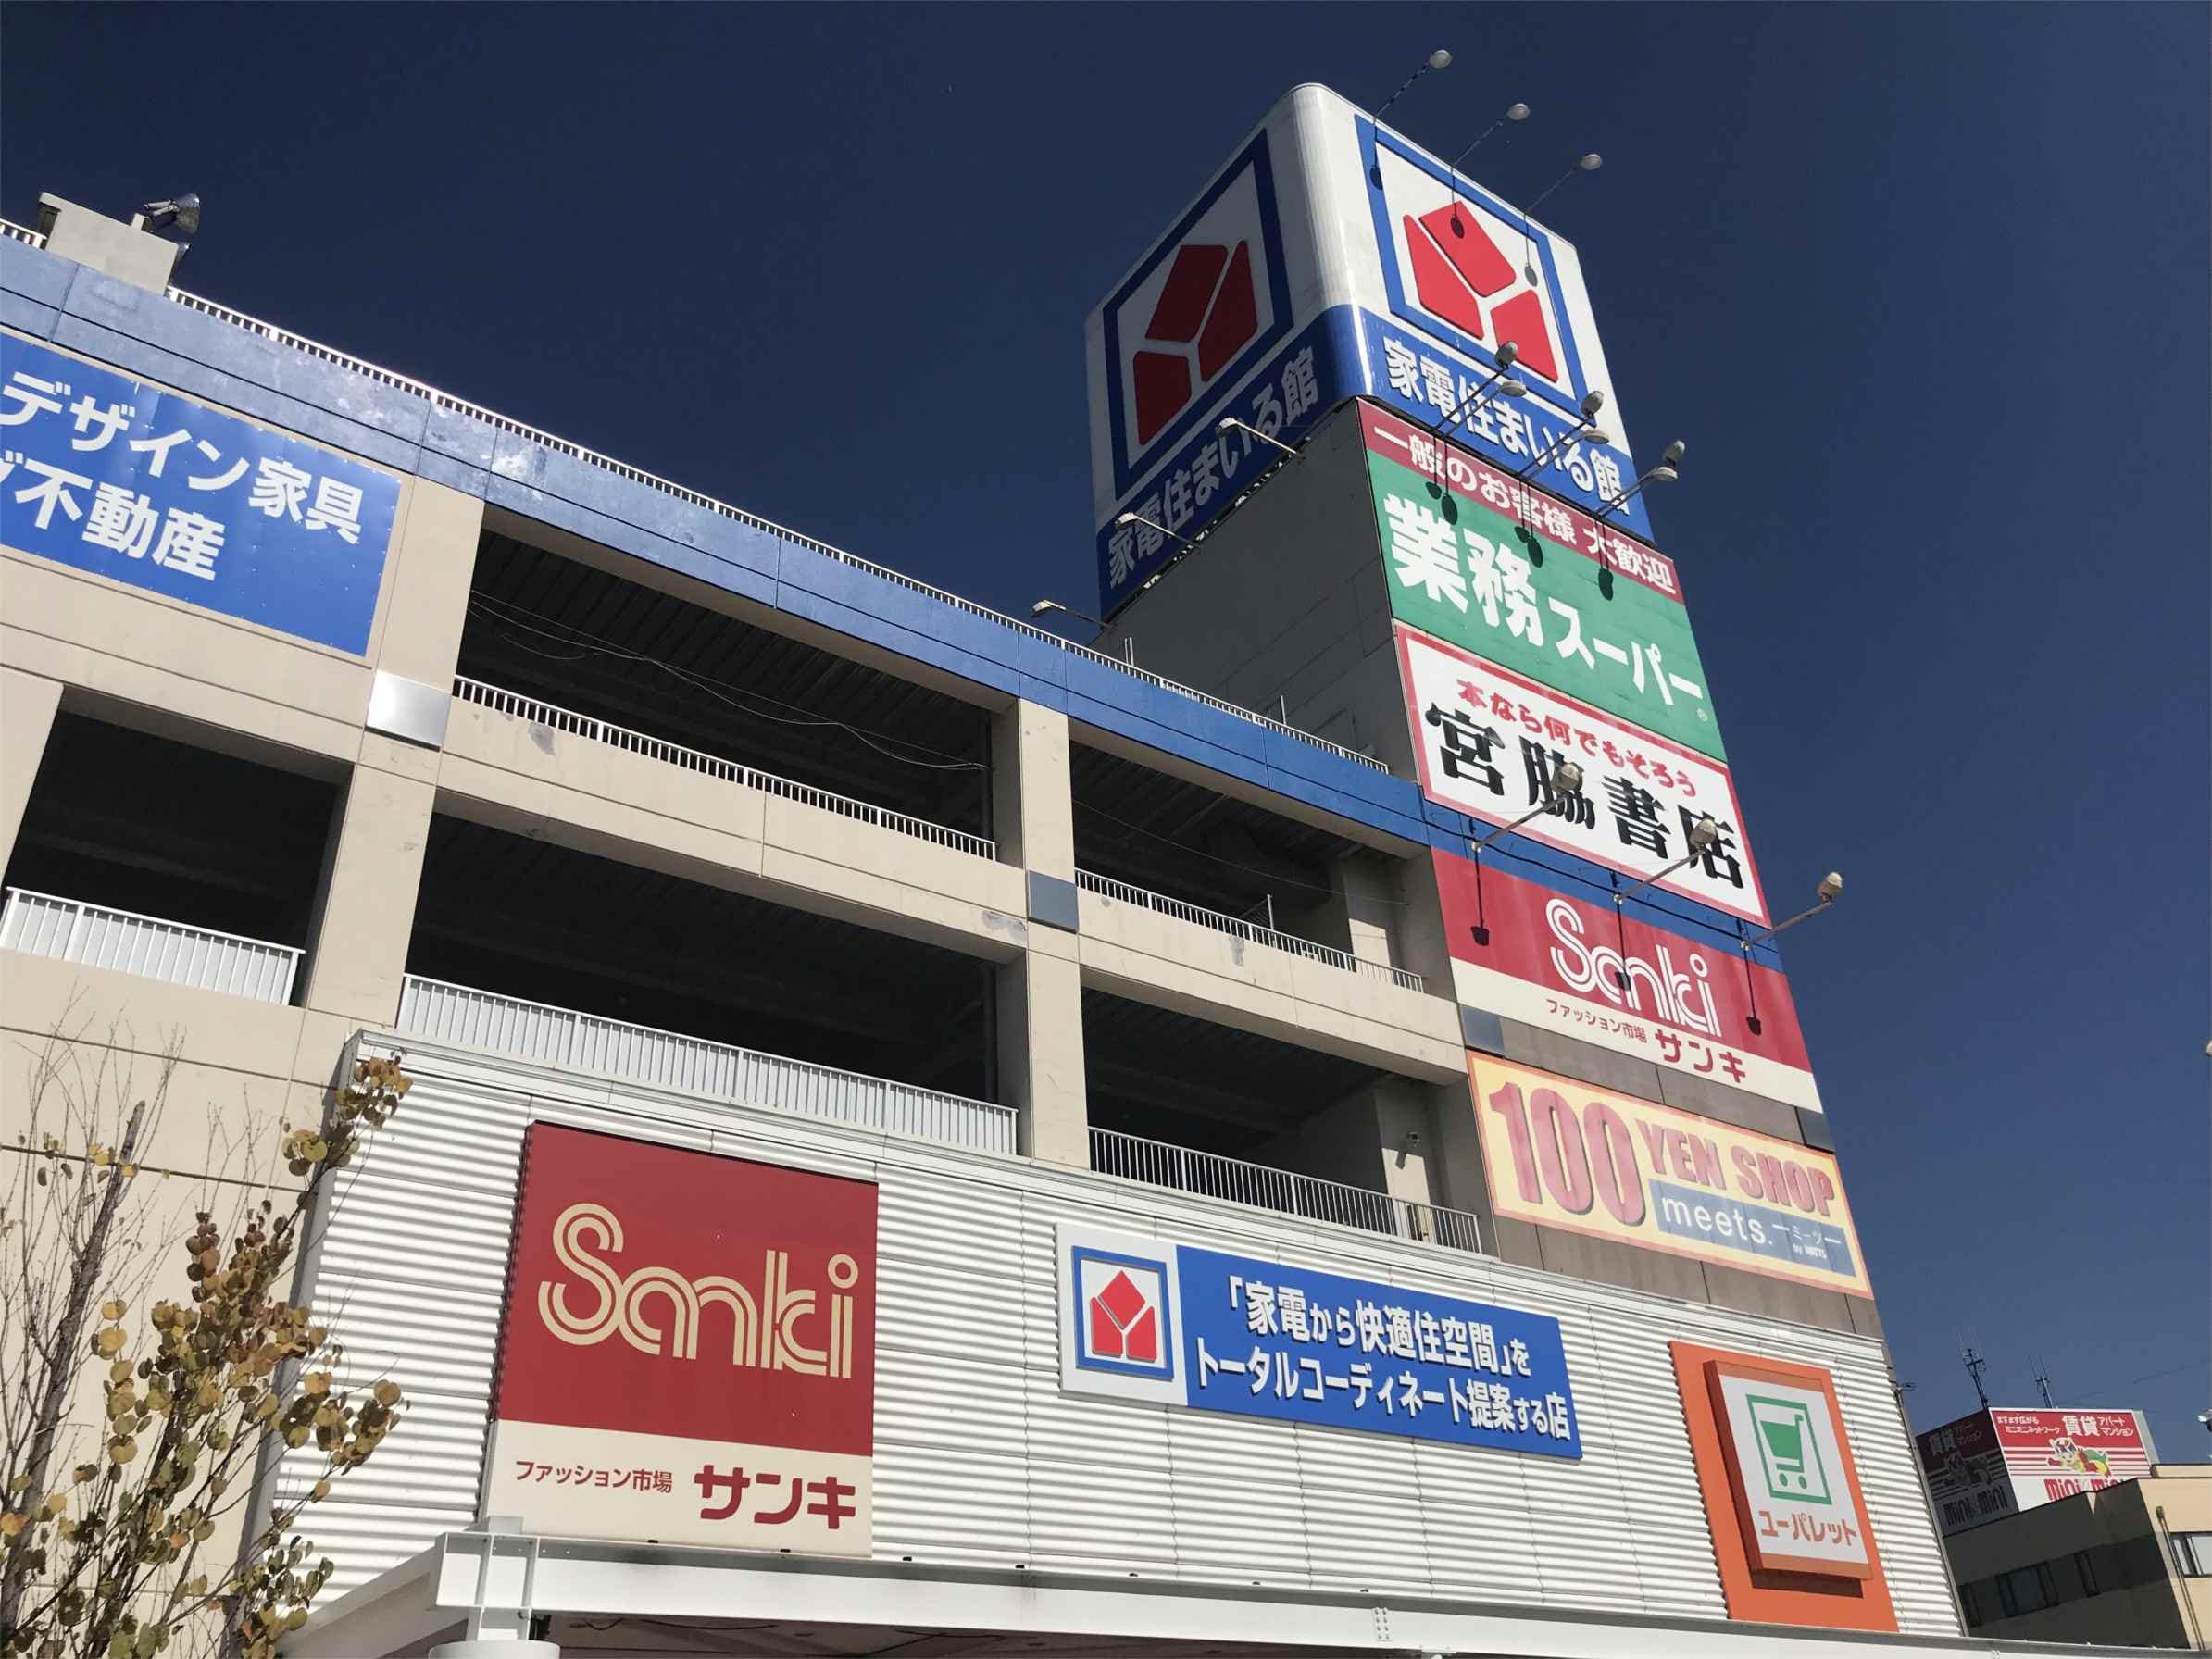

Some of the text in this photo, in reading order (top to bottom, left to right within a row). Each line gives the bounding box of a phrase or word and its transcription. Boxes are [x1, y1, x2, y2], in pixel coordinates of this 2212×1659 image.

[0, 371, 363, 544] デザイン家具
[1108, 346, 1318, 589] 家電住まいる館
[1383, 336, 1631, 515] 家電住まいる館
[1373, 426, 1677, 594] 一般のお客様 大歓迎
[1384, 493, 1704, 705] 業務スーパー
[1425, 702, 1743, 889] 宮脇書店
[1456, 678, 1697, 797] 本なら何でもそろう
[1545, 898, 1721, 1037] Sanki
[1545, 999, 1746, 1083] ファッション市場 サンキ
[1489, 1081, 1834, 1227] 100 YEN SHOP
[537, 1203, 859, 1378] Sanki
[1228, 1275, 1532, 1378] 「家電から快適住空間」を
[1196, 1337, 1571, 1441] トータルコーディネート提案する店
[515, 1460, 856, 1529] ファッション市場 サンキ
[1758, 1509, 1858, 1547] ユーパレット
